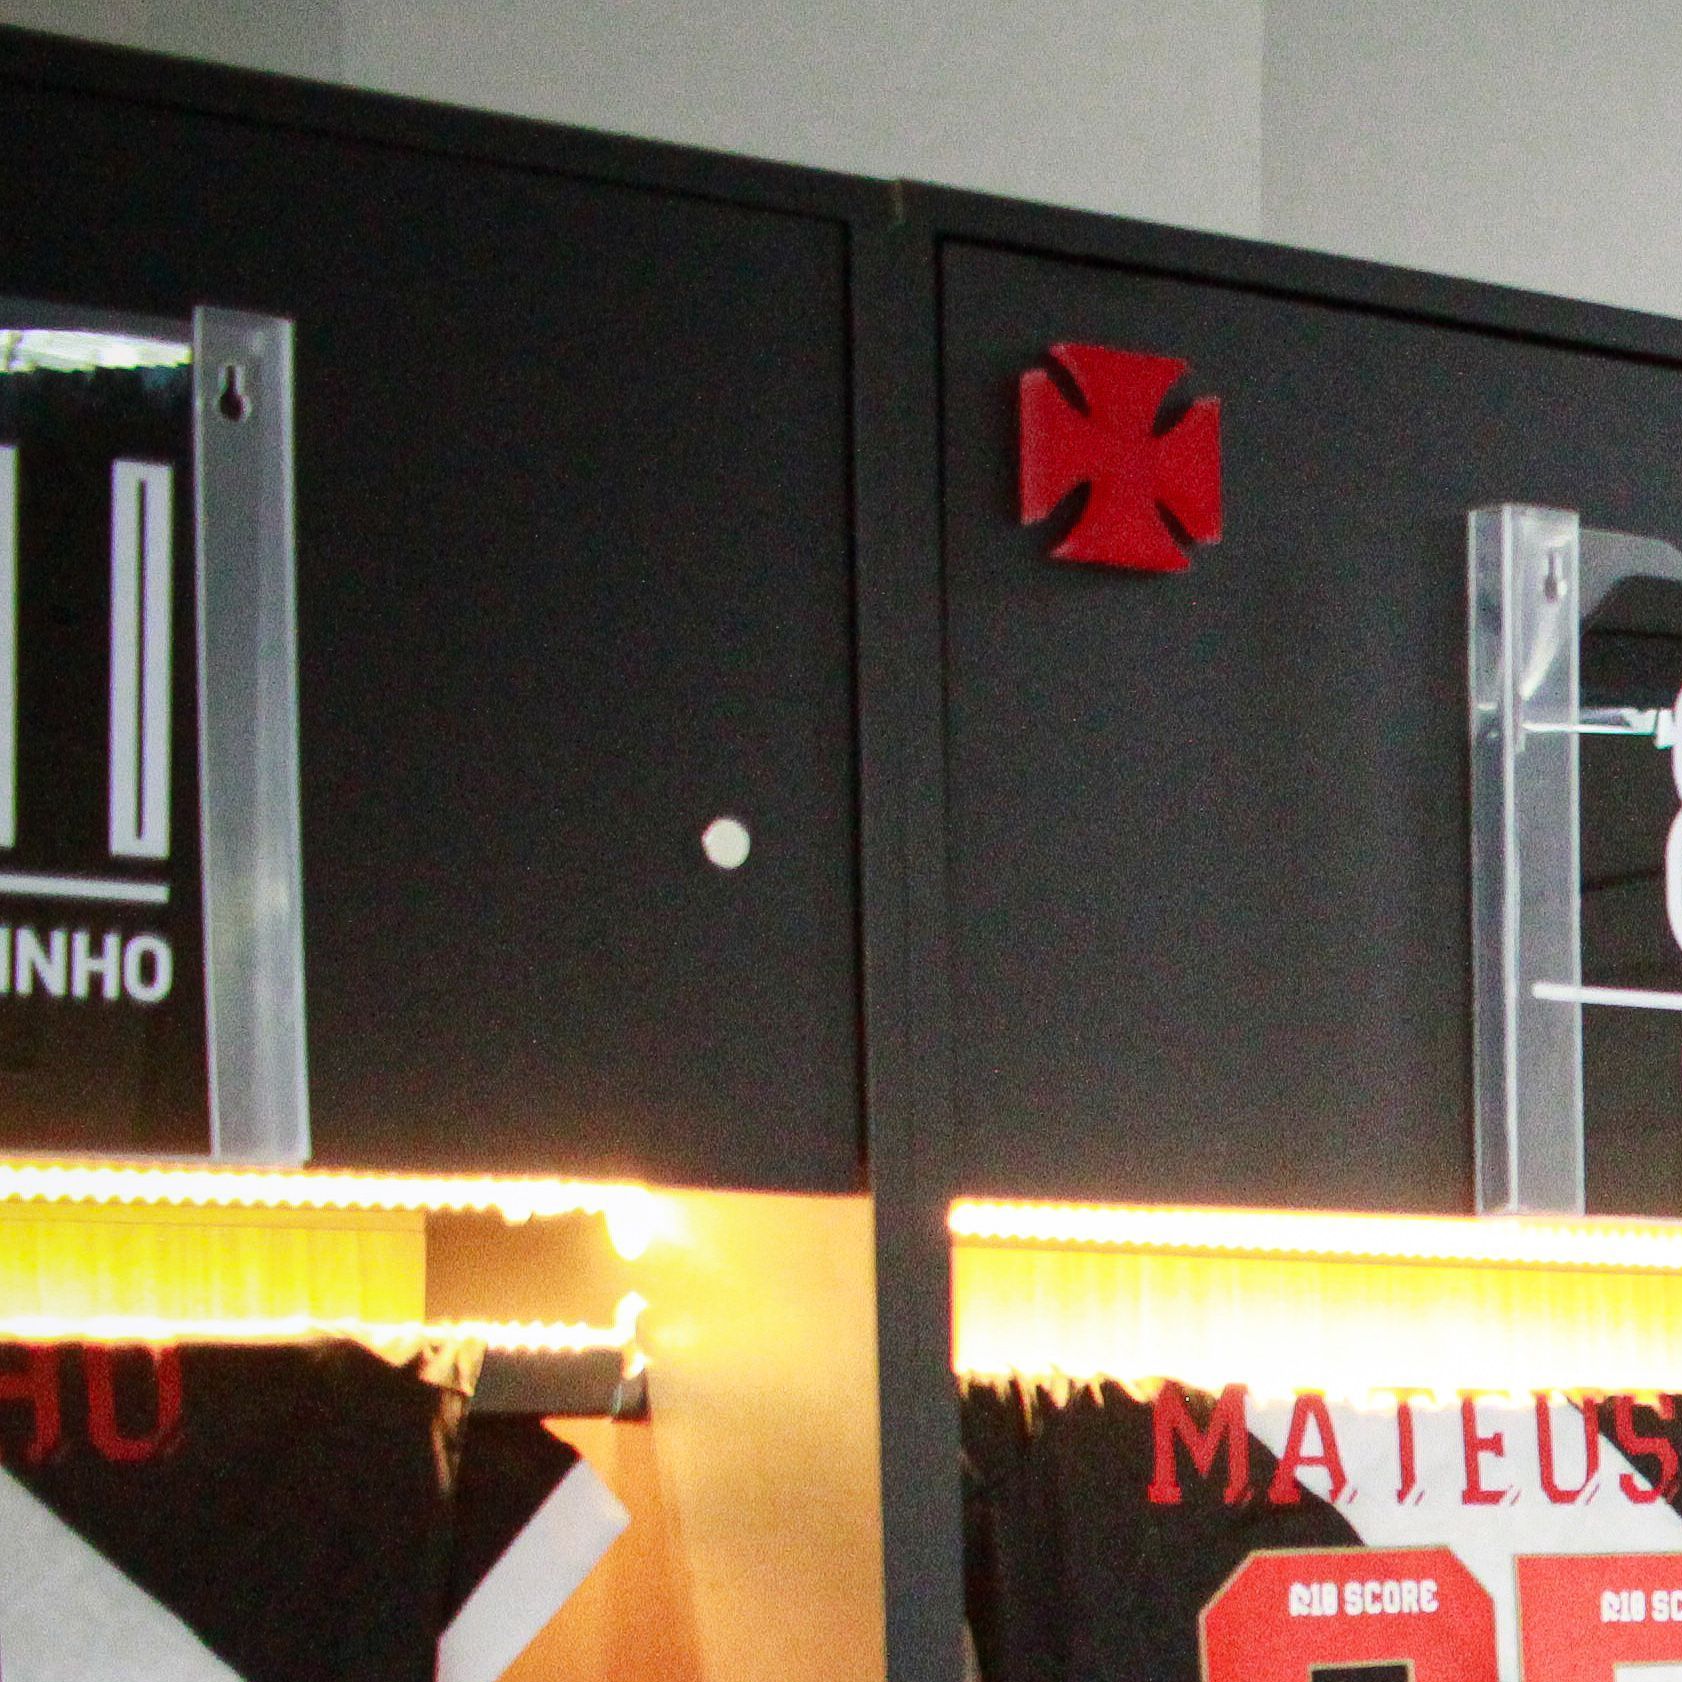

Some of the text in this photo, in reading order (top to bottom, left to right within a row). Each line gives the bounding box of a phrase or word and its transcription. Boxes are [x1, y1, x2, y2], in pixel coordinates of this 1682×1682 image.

[0, 443, 173, 860] 1
[1146, 1384, 1681, 1507] MATEUS
[1344, 1580, 1439, 1615] SCORE
